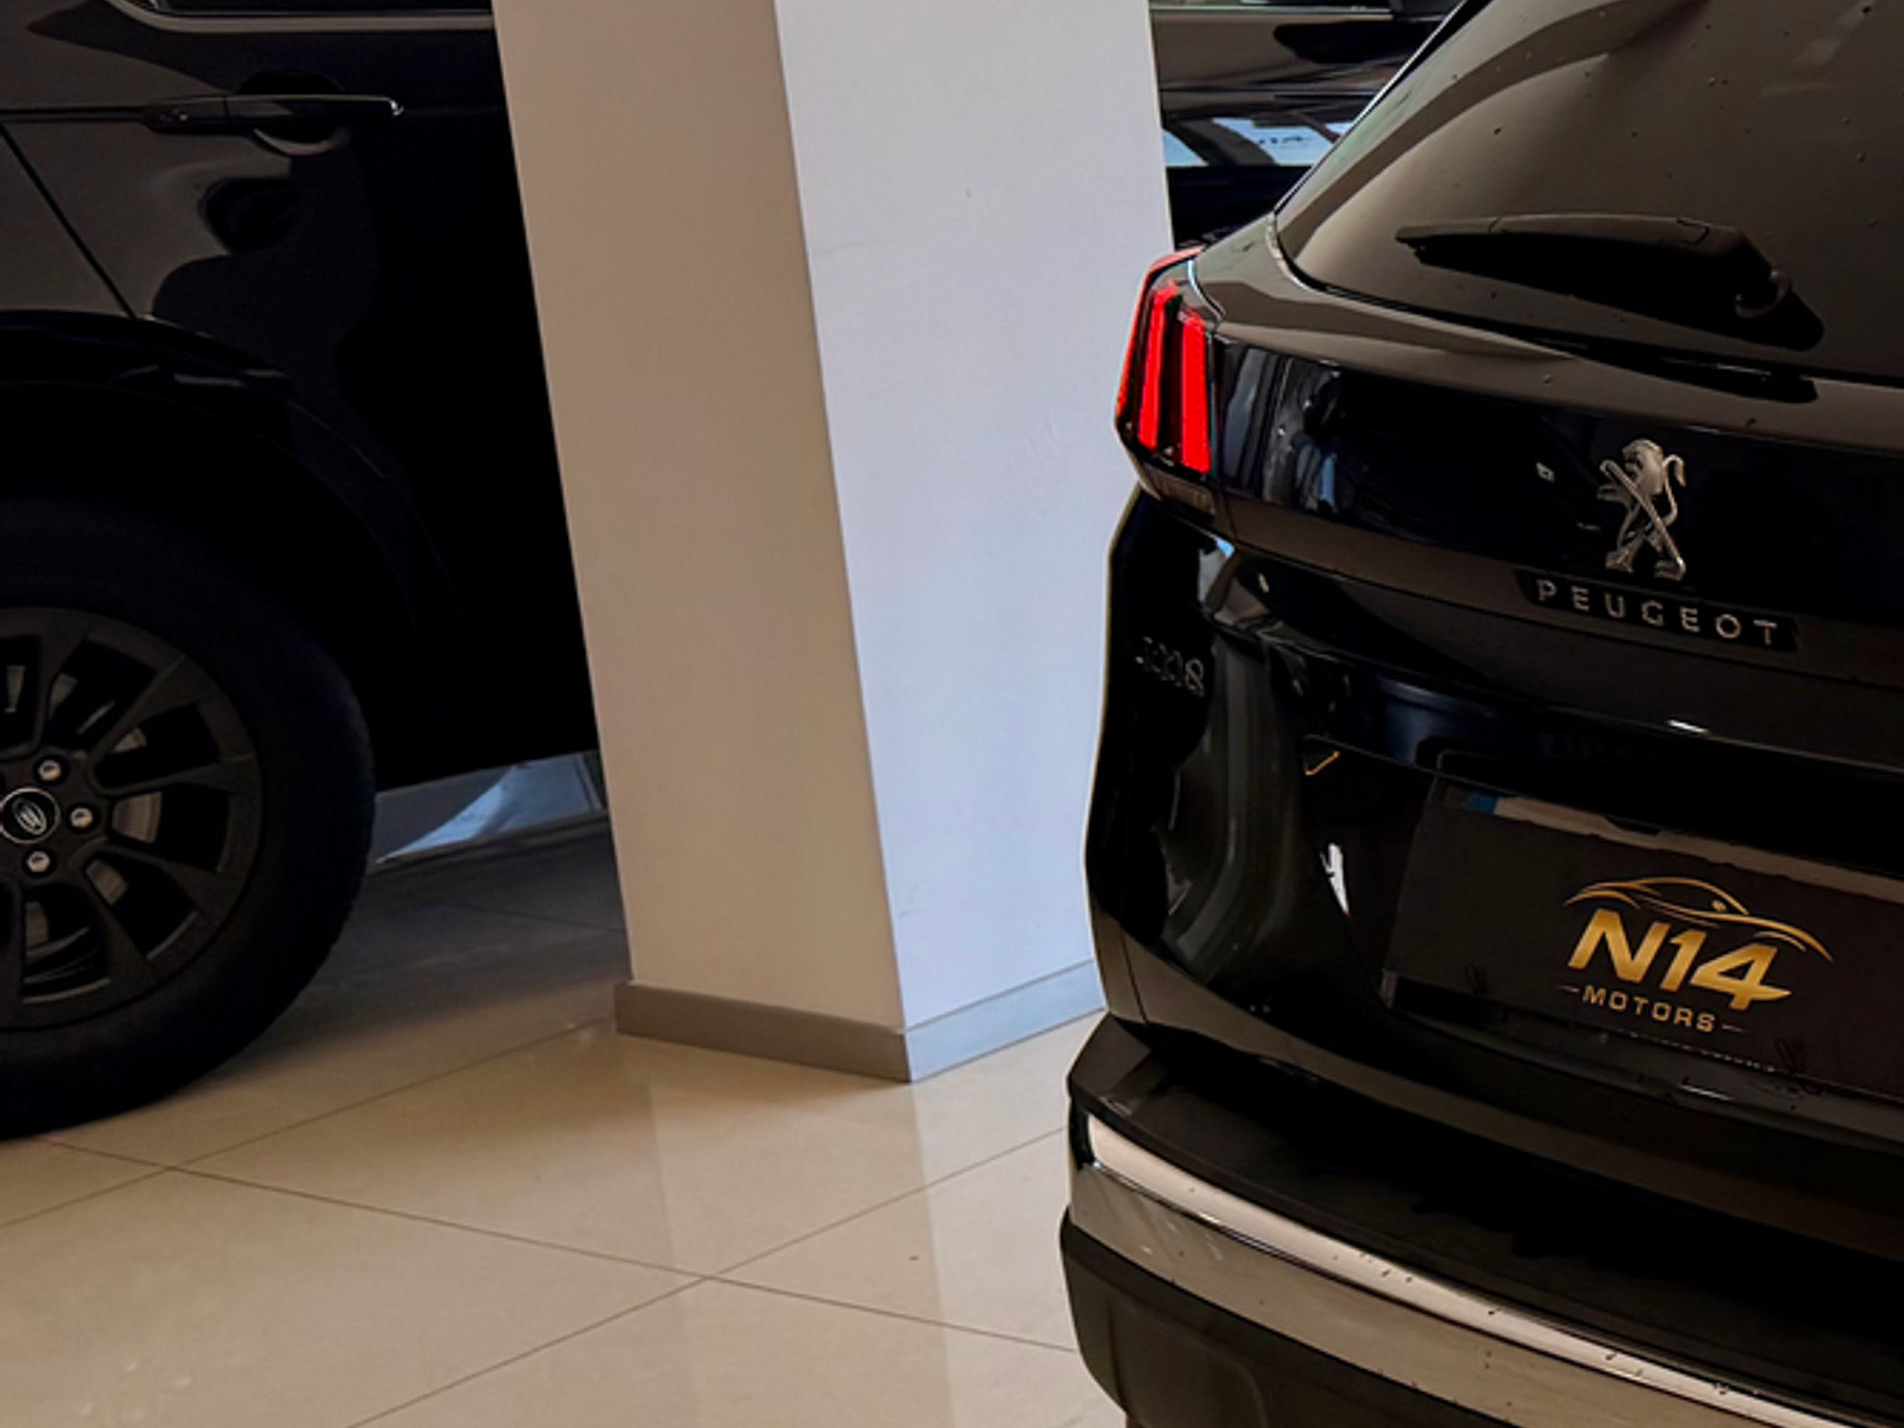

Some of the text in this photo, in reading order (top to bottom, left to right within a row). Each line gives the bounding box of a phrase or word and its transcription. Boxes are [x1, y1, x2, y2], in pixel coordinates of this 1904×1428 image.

[1536, 578, 1778, 647] PEUGEOT
[1566, 908, 1792, 1011] N14
[1582, 983, 1716, 1034] MOTORS
